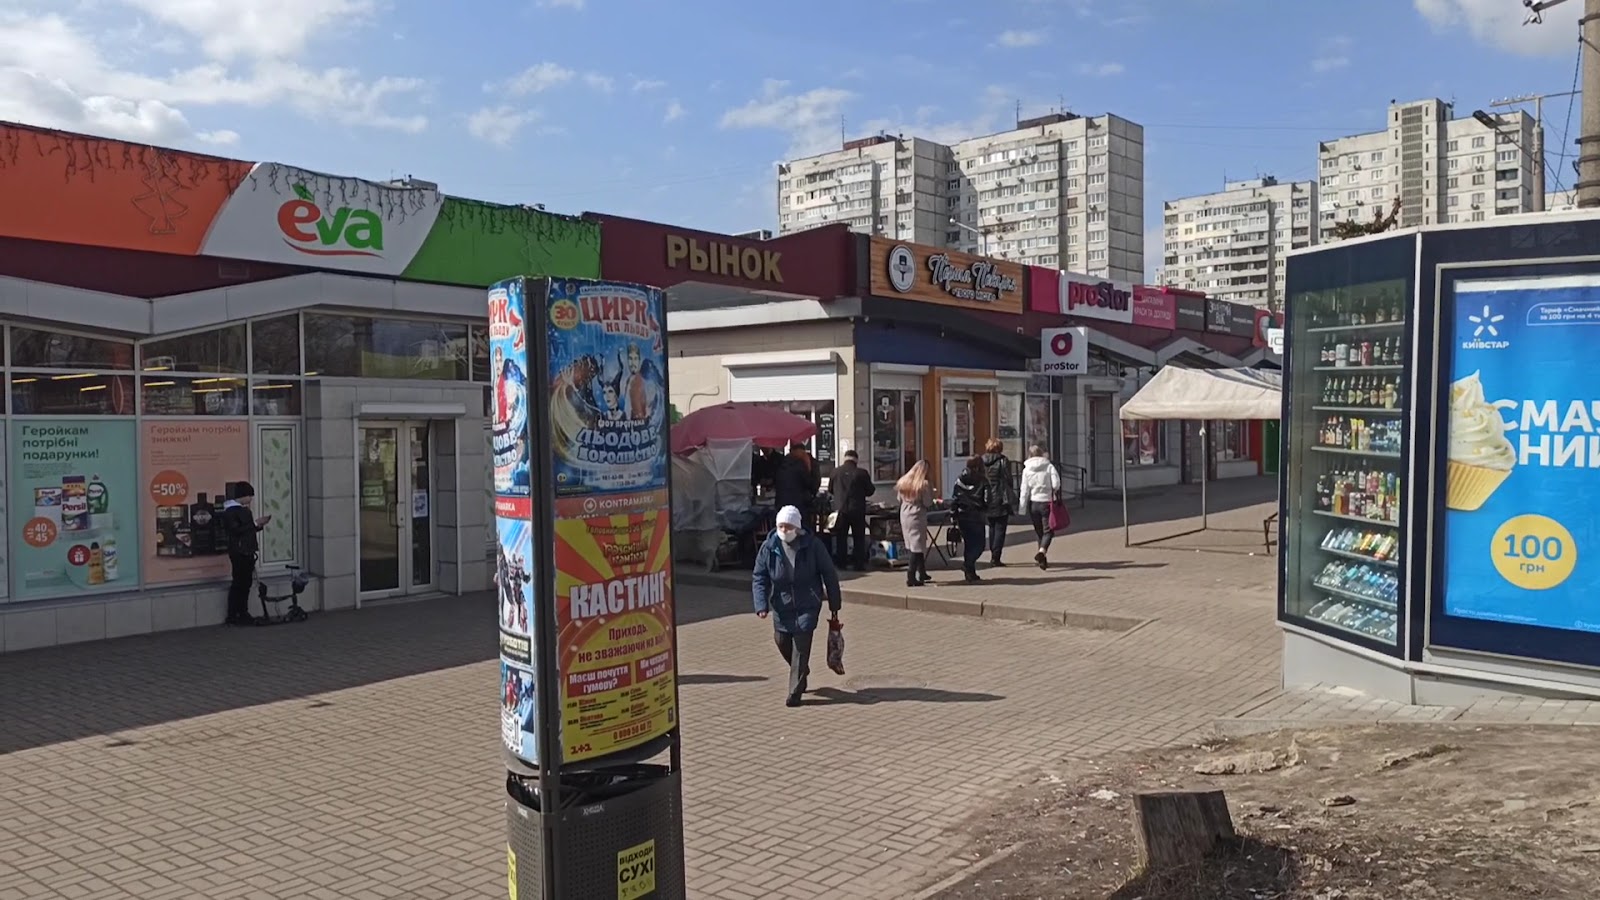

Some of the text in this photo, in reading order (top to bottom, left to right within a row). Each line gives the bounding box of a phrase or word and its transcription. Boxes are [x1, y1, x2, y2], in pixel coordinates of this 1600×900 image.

[277, 198, 384, 251] eva
[666, 234, 784, 283] РЫНОК
[1068, 281, 1132, 311] proStor
[579, 295, 648, 326] ЦИРК
[606, 322, 620, 333] НА
[1462, 338, 1510, 349] КИЇВСТАР
[1044, 361, 1080, 373] proStor
[22, 425, 89, 438] Геройкам
[151, 425, 241, 435] Геройкам потрібні
[23, 437, 78, 450] потрібні
[151, 435, 191, 444] знижки!
[23, 449, 99, 461] подарунки!
[62, 502, 86, 511] Persil
[1504, 533, 1563, 561] 100
[1519, 562, 1545, 574] грн
[570, 571, 667, 619] КАСТИНГ
[609, 623, 647, 640] Приходь
[578, 652, 592, 663] не
[595, 642, 646, 661] зважаючи
[597, 665, 629, 679] почуття
[583, 677, 618, 693] гумору?
[570, 743, 592, 755] 1+1
[620, 845, 653, 866] ВІДХОДИ
[620, 857, 653, 884] СУХІ
